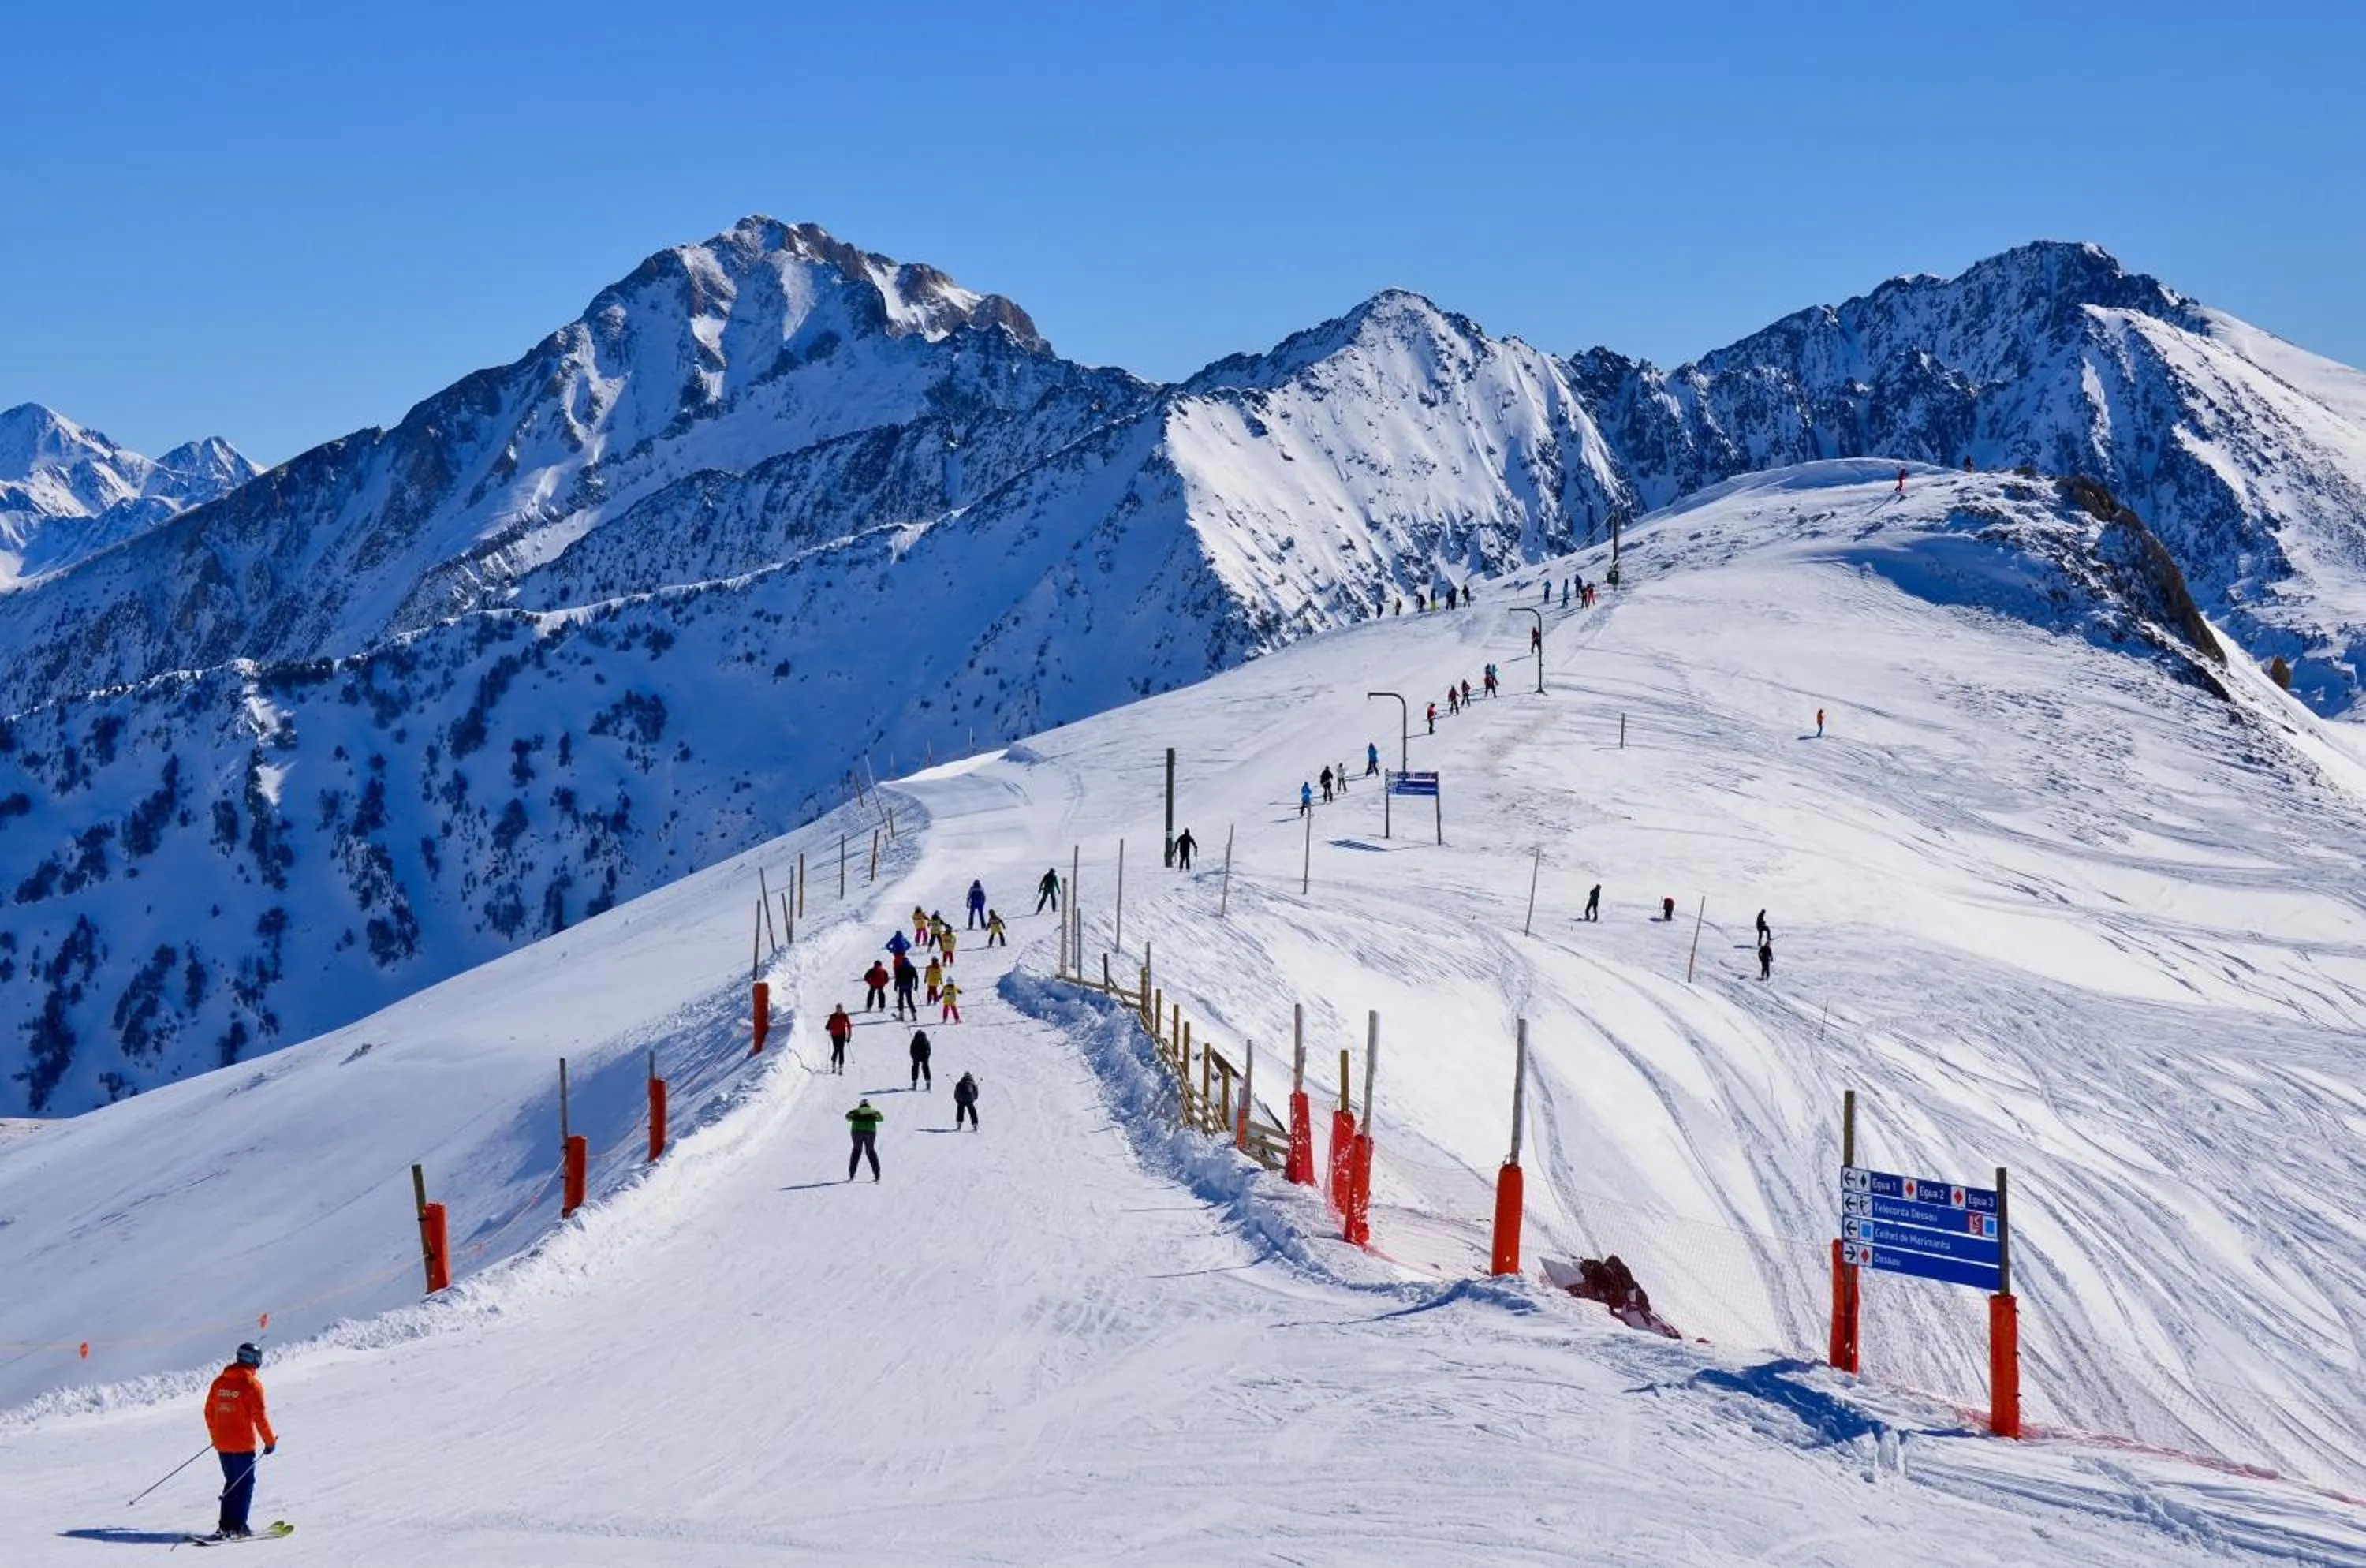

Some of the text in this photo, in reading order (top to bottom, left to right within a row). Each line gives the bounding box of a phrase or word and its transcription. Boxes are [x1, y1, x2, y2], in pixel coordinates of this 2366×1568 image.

[1872, 1178, 1890, 1191] Egua
[1919, 1185, 1945, 1200] Egua 2
[1968, 1193, 1995, 1208] Egua 3
